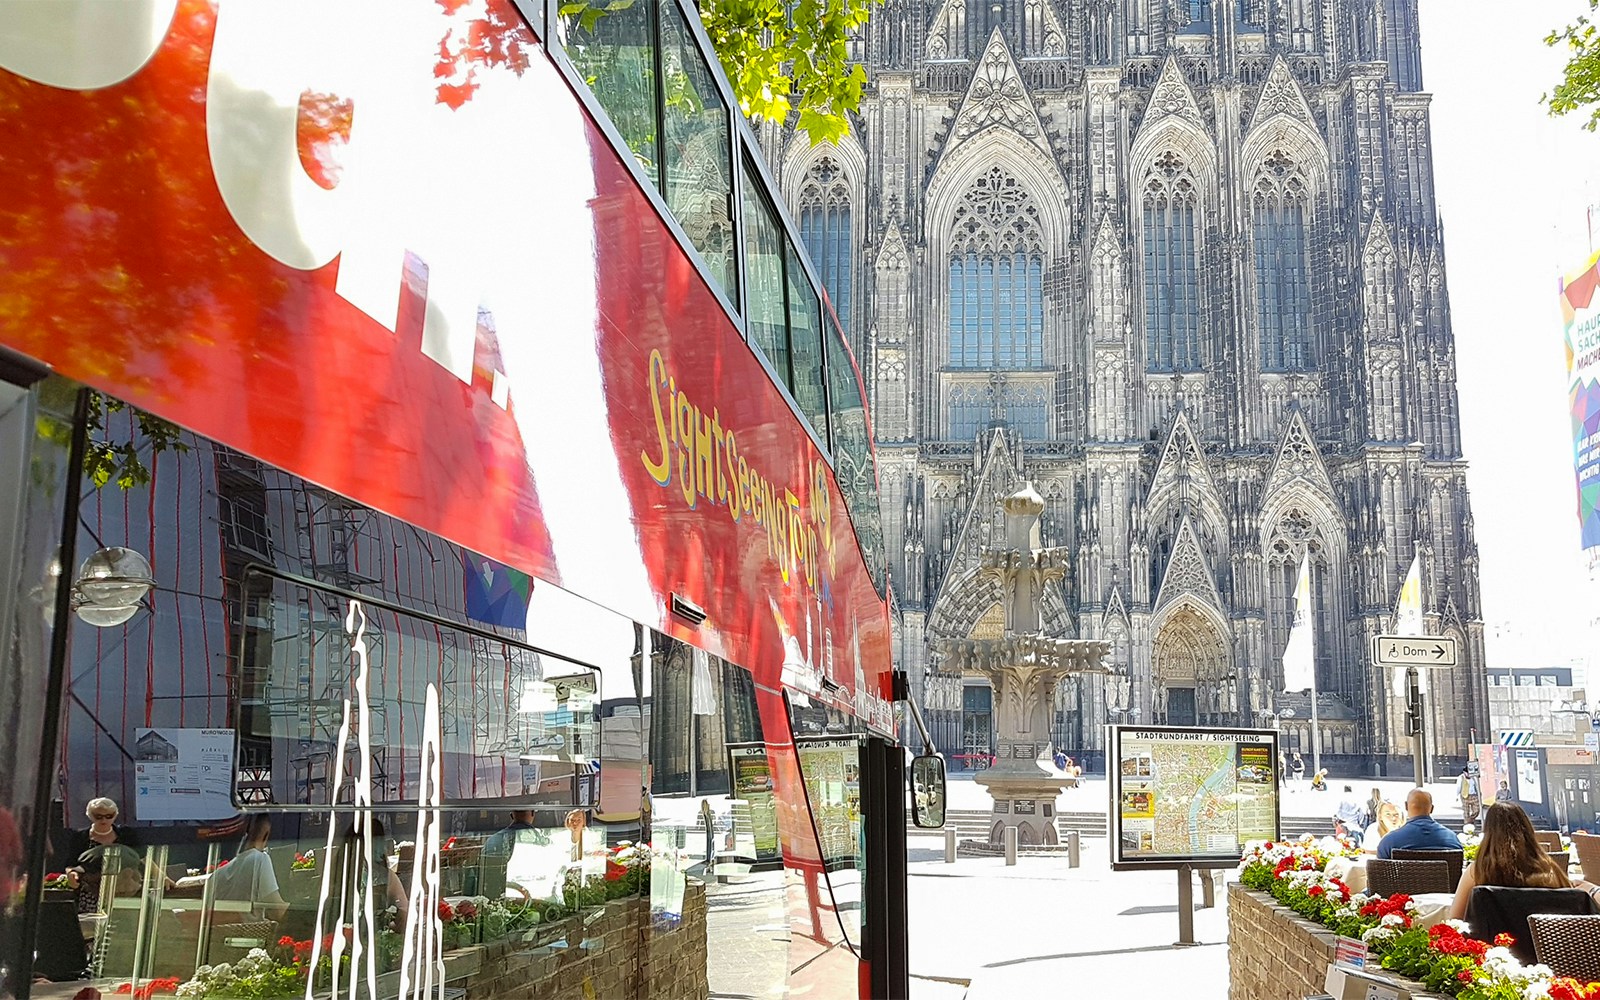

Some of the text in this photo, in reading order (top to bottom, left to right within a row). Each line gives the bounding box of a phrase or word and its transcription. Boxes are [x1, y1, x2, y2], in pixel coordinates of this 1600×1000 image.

[1403, 646, 1427, 656] Dom
[1135, 732, 1203, 741] STADTRUNDFAHRT
[1213, 734, 1260, 742] SIGHTSEEING
